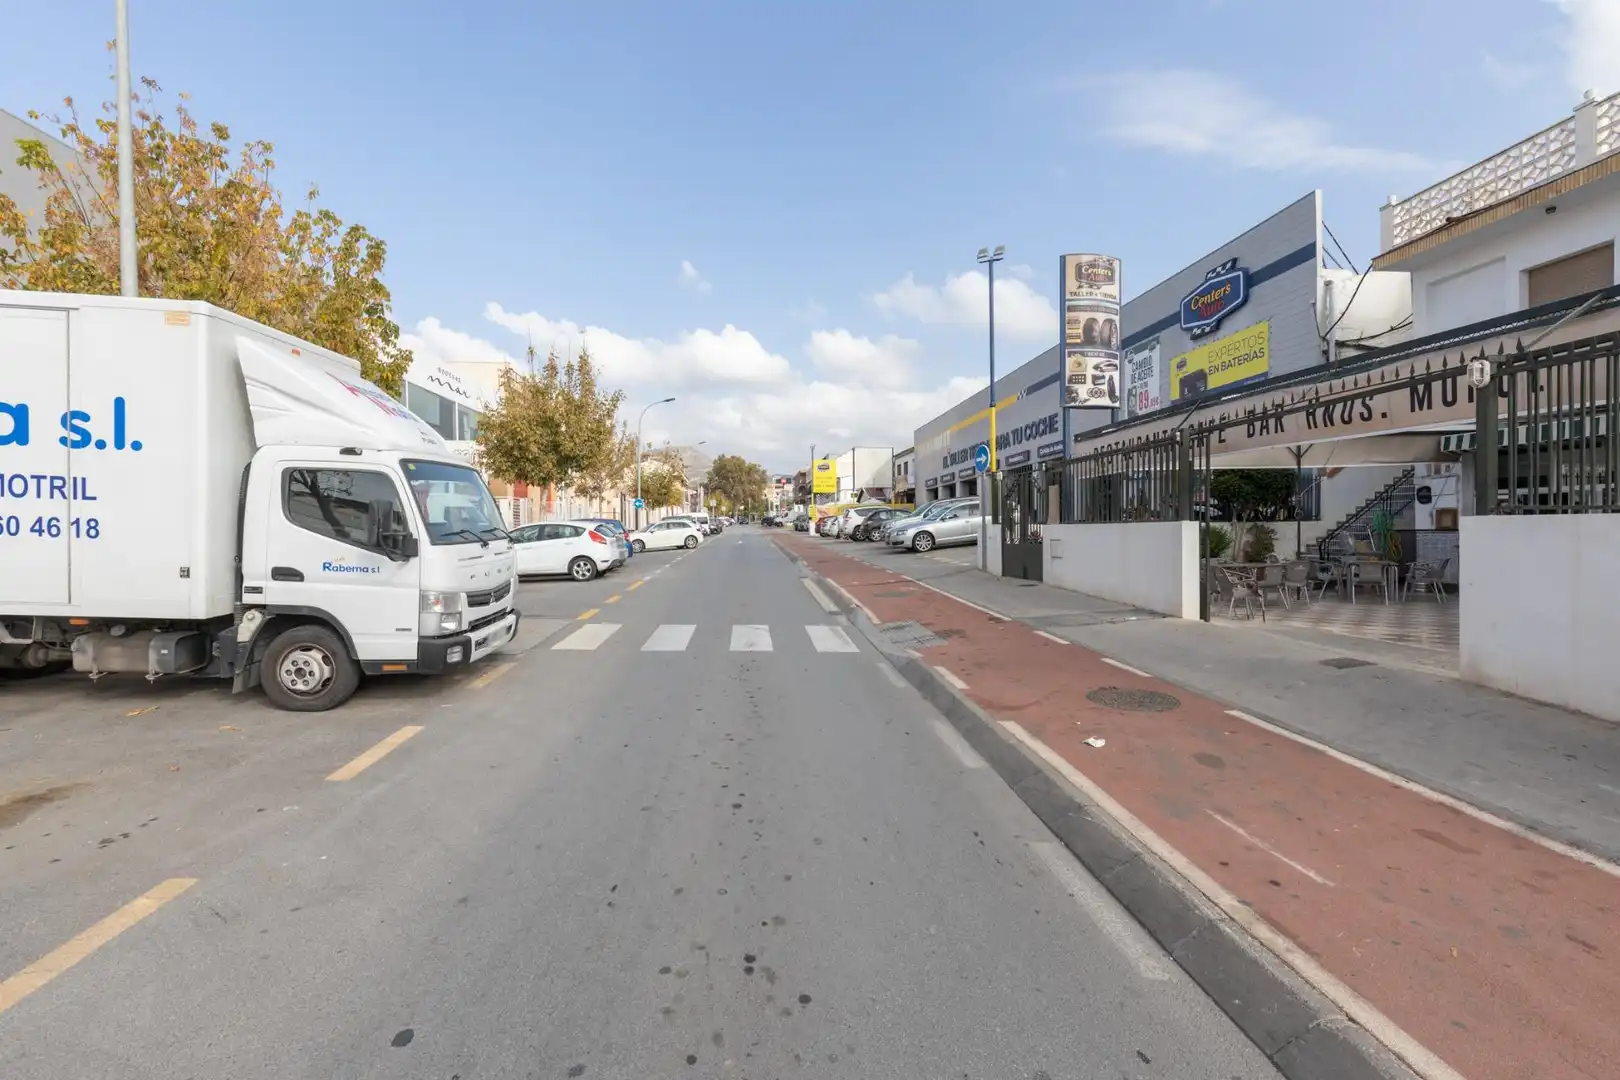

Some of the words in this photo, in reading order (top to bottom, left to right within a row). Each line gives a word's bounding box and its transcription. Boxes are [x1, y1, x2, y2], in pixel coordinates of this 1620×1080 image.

[1208, 331, 1266, 364] EXPERTOS
[1208, 365, 1220, 376] EN
[1221, 347, 1265, 371] BATERÍAS
[1131, 354, 1153, 373] CAMBIO
[1131, 373, 1137, 385] DE
[58, 396, 143, 452] s.l.
[1011, 427, 1023, 446] TU
[1024, 412, 1060, 441] COCHE
[0, 473, 98, 501] OTRIL
[0, 515, 20, 537] 0
[30, 516, 61, 538] 46
[70, 517, 100, 539] 18
